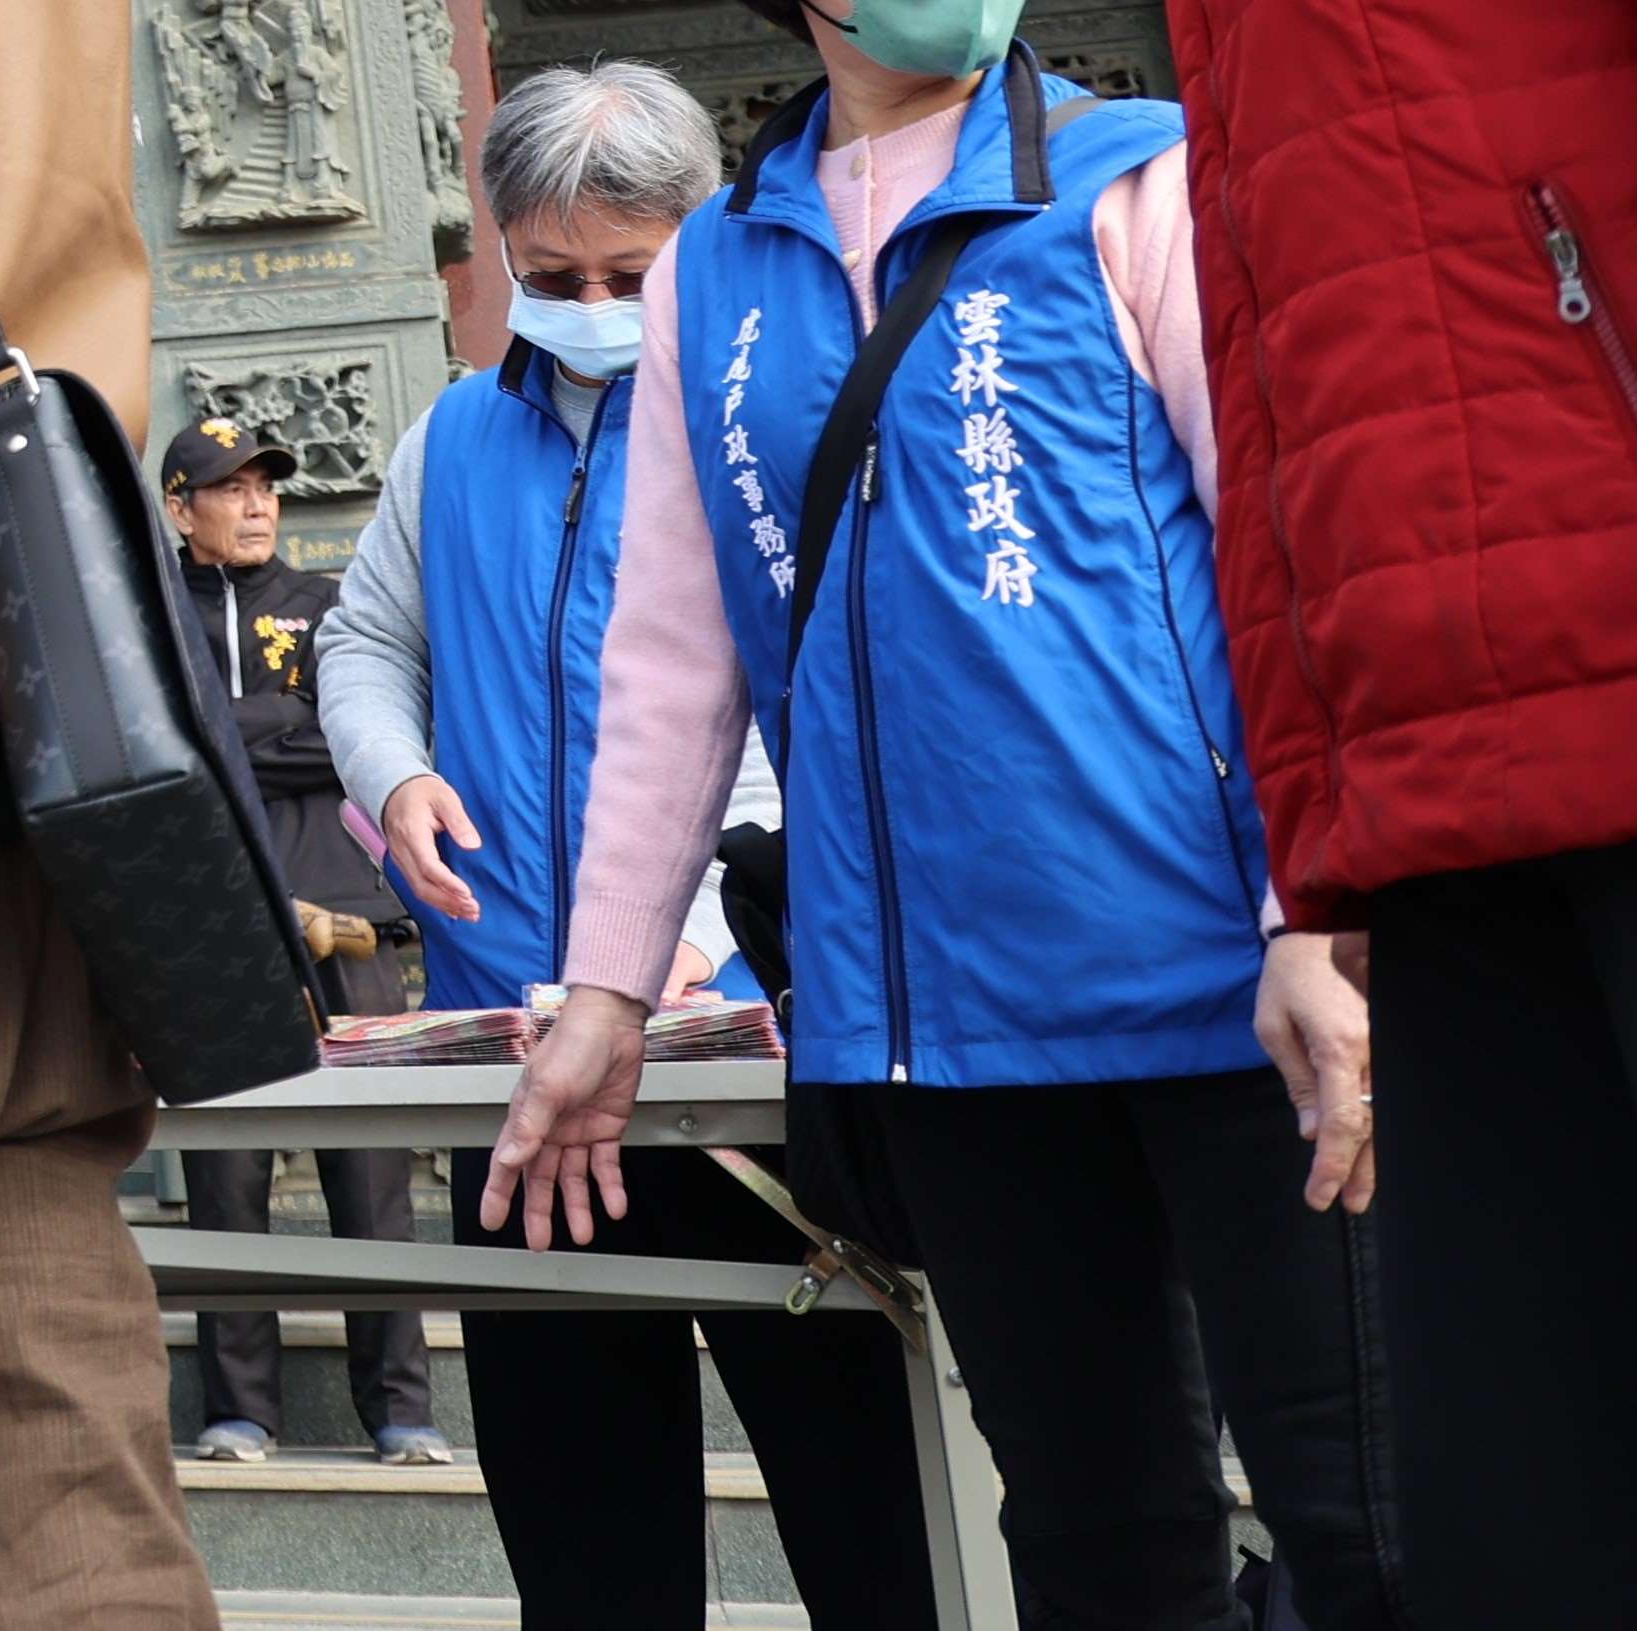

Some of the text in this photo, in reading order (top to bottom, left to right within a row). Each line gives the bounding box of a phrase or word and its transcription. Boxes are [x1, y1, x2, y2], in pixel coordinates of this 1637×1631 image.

[721, 306, 797, 599] 虎尾戶政事務所
[950, 289, 1037, 607] 雲林縣政府
